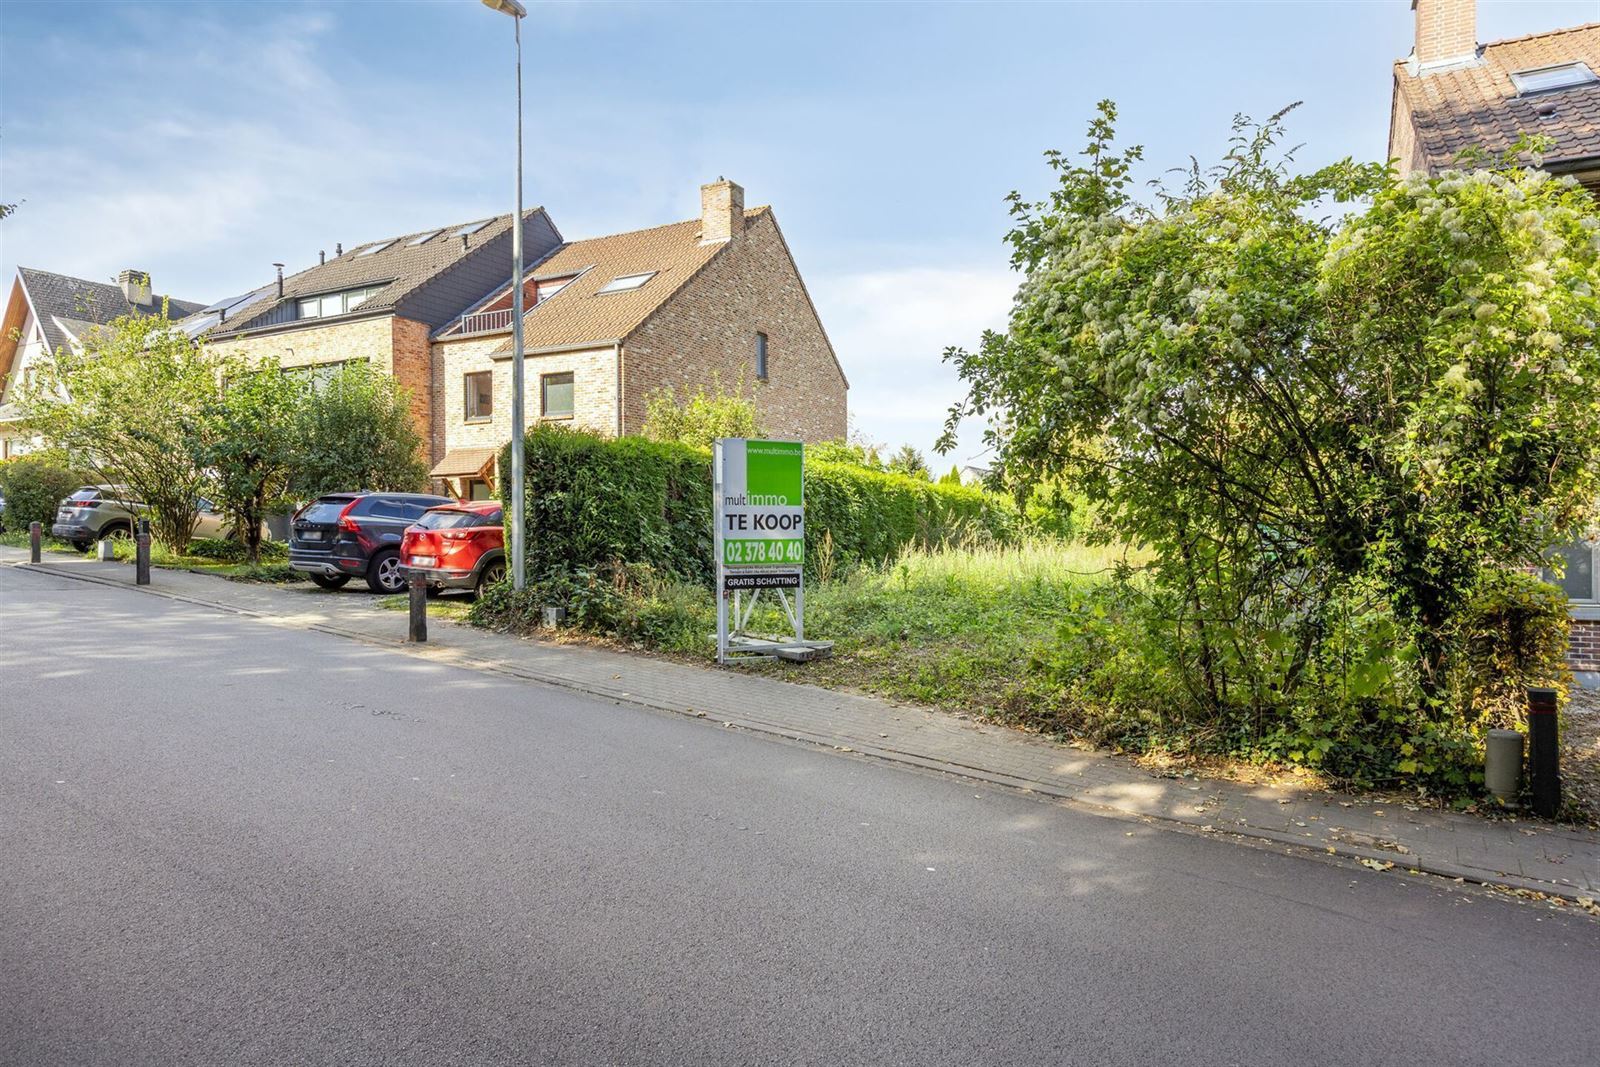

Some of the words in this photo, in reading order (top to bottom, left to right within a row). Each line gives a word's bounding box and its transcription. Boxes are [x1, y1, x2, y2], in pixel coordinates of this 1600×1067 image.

[725, 514, 748, 530] TE
[753, 514, 802, 530] KOOP
[726, 542, 742, 562] 02
[744, 542, 766, 561] 378
[768, 541, 784, 561] 40
[786, 541, 801, 560] 40
[727, 578, 755, 586] GRATIS
[756, 577, 798, 585] SCHATTING
